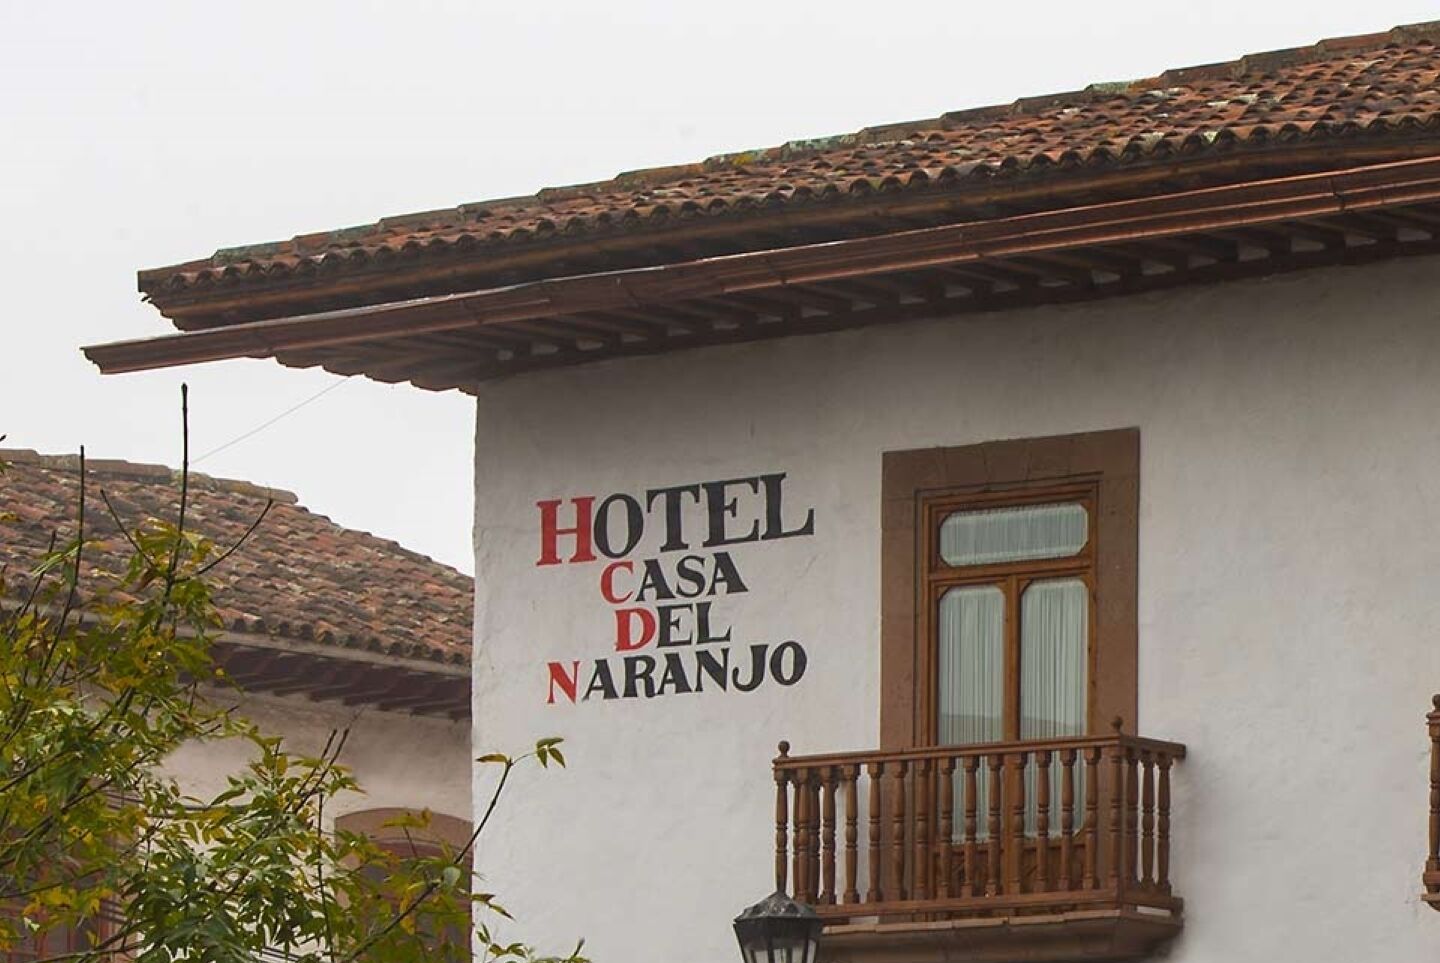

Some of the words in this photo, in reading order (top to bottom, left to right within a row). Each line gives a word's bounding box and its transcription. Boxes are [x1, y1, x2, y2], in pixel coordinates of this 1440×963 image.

[536, 472, 815, 566] HOTEL
[600, 551, 749, 604] CASA
[615, 601, 732, 652] DEL
[546, 640, 808, 704] NARANJO
